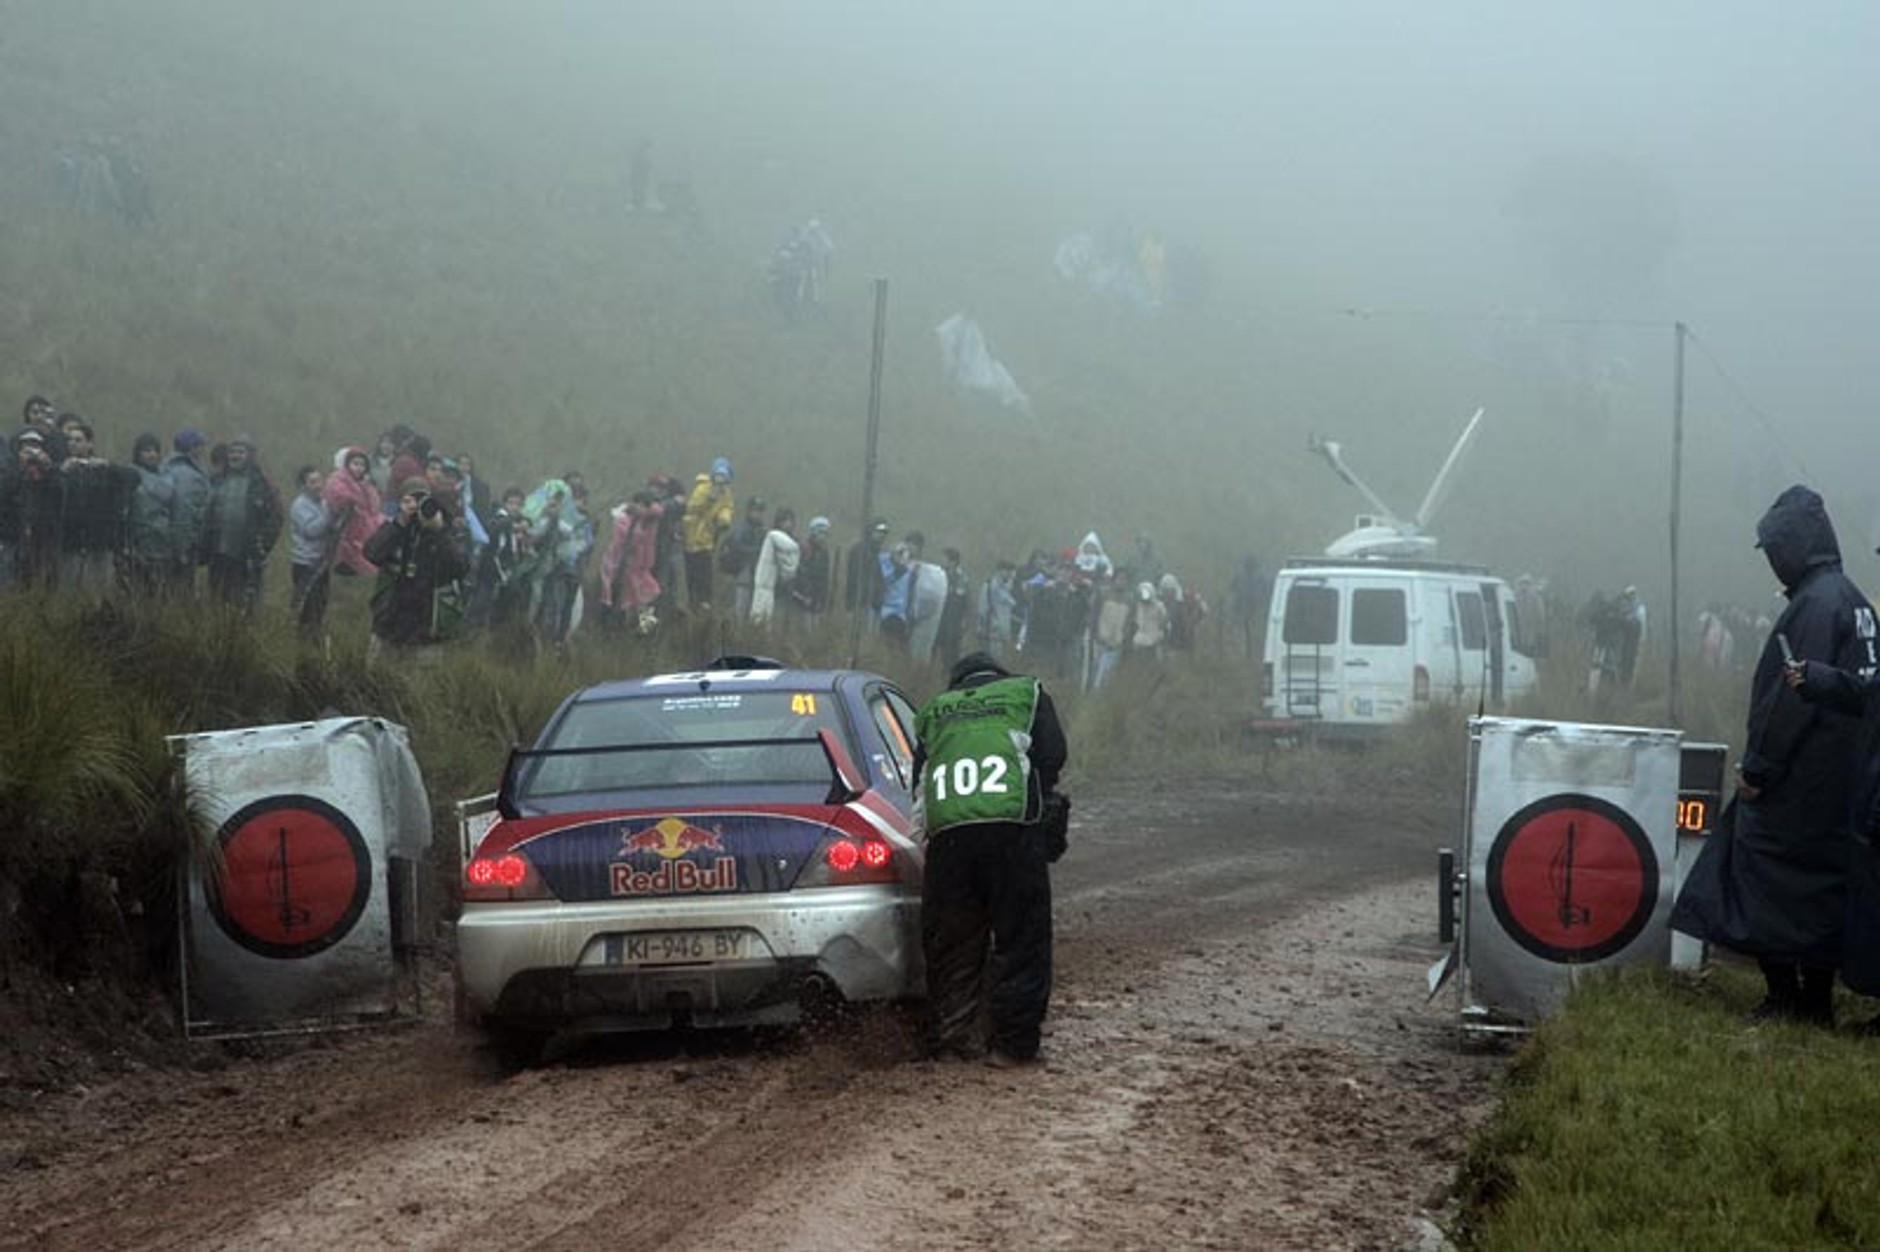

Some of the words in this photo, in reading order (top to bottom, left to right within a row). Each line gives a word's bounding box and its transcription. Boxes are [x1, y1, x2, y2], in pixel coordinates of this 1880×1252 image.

[791, 694, 816, 715] 41
[932, 755, 1008, 801] 102
[609, 860, 673, 896] Red
[674, 856, 737, 892] Bull
[627, 935, 704, 960] KI-946
[714, 933, 742, 956] BY
